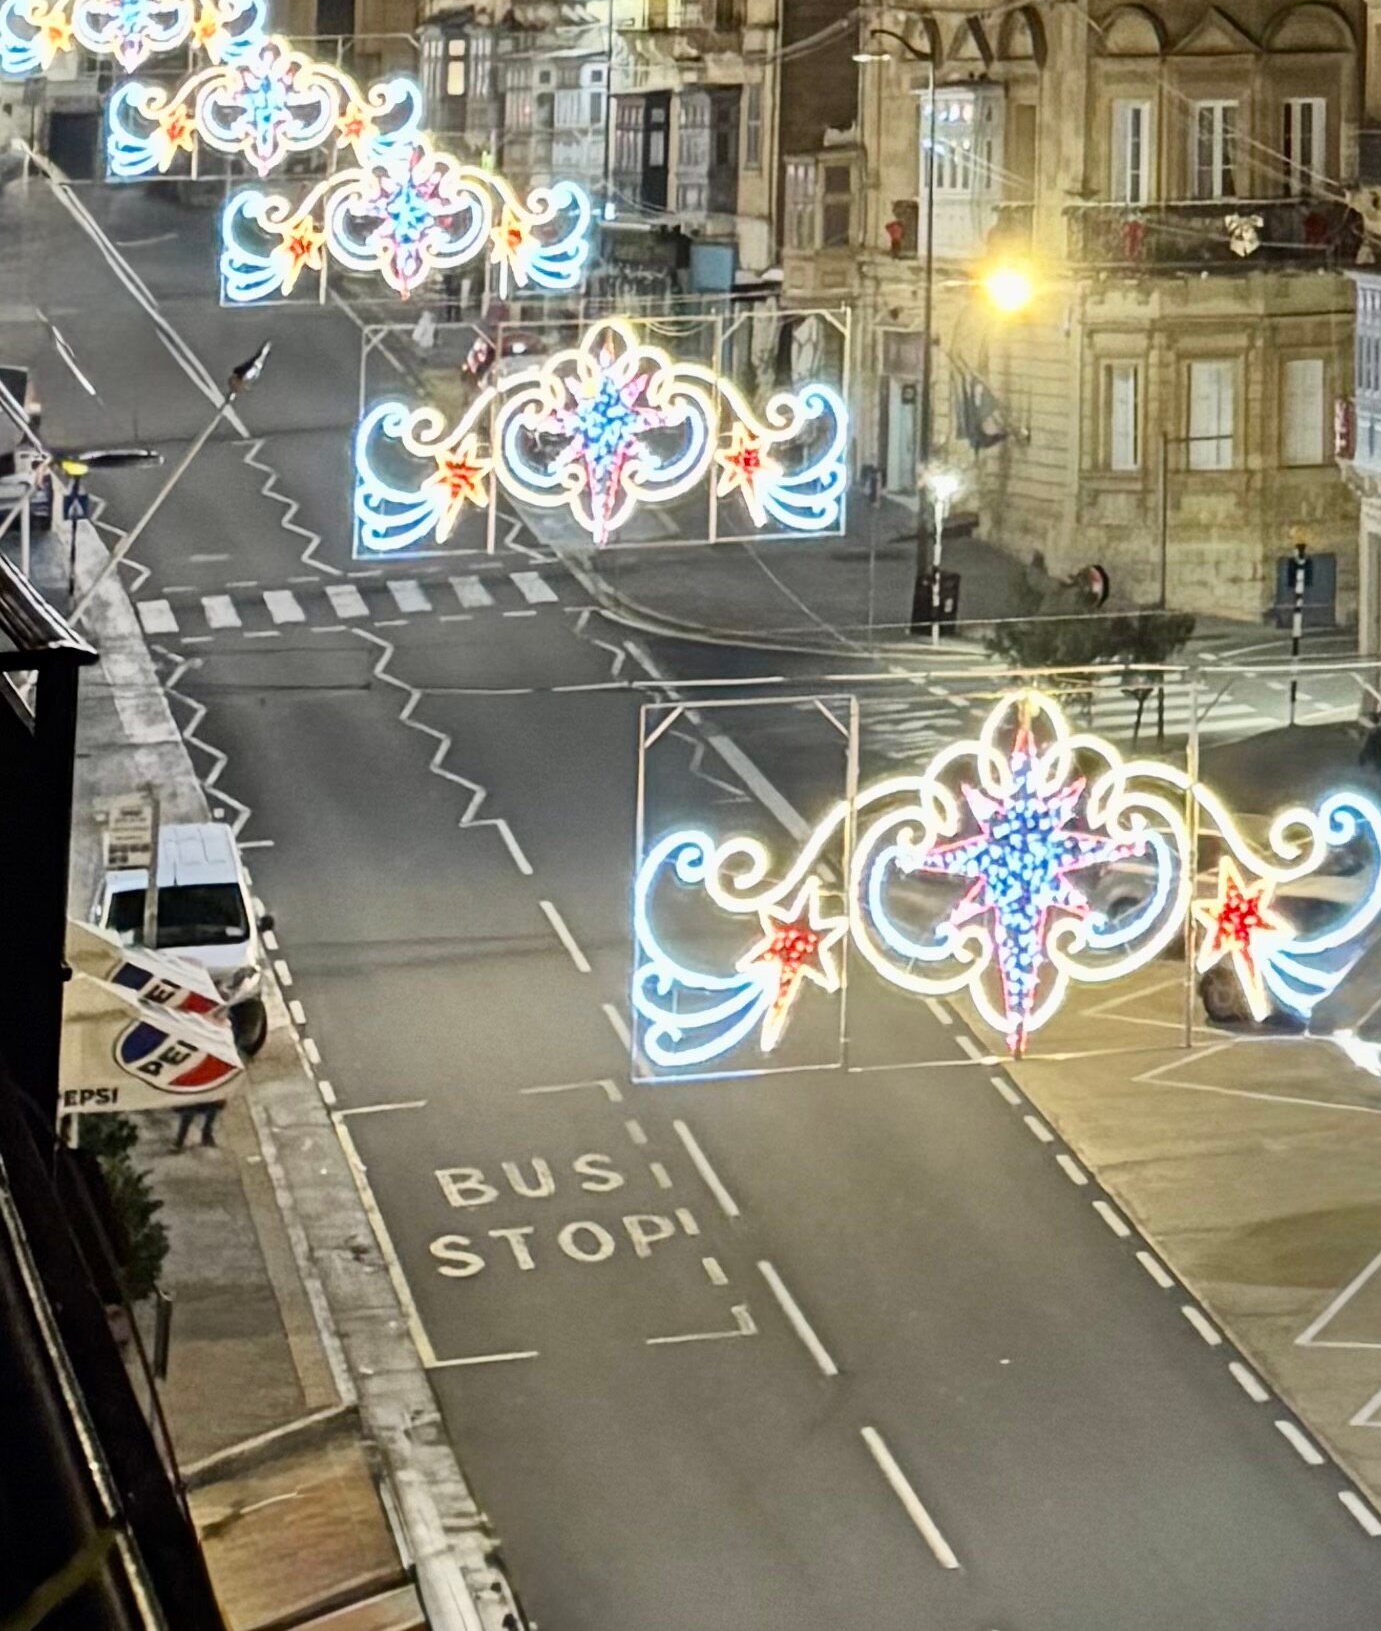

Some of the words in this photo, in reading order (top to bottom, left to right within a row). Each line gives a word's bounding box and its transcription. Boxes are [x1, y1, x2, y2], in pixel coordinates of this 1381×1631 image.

[59, 1087, 118, 1107] EPSI
[434, 1153, 625, 1207] BUS
[429, 1214, 676, 1278] STOP
